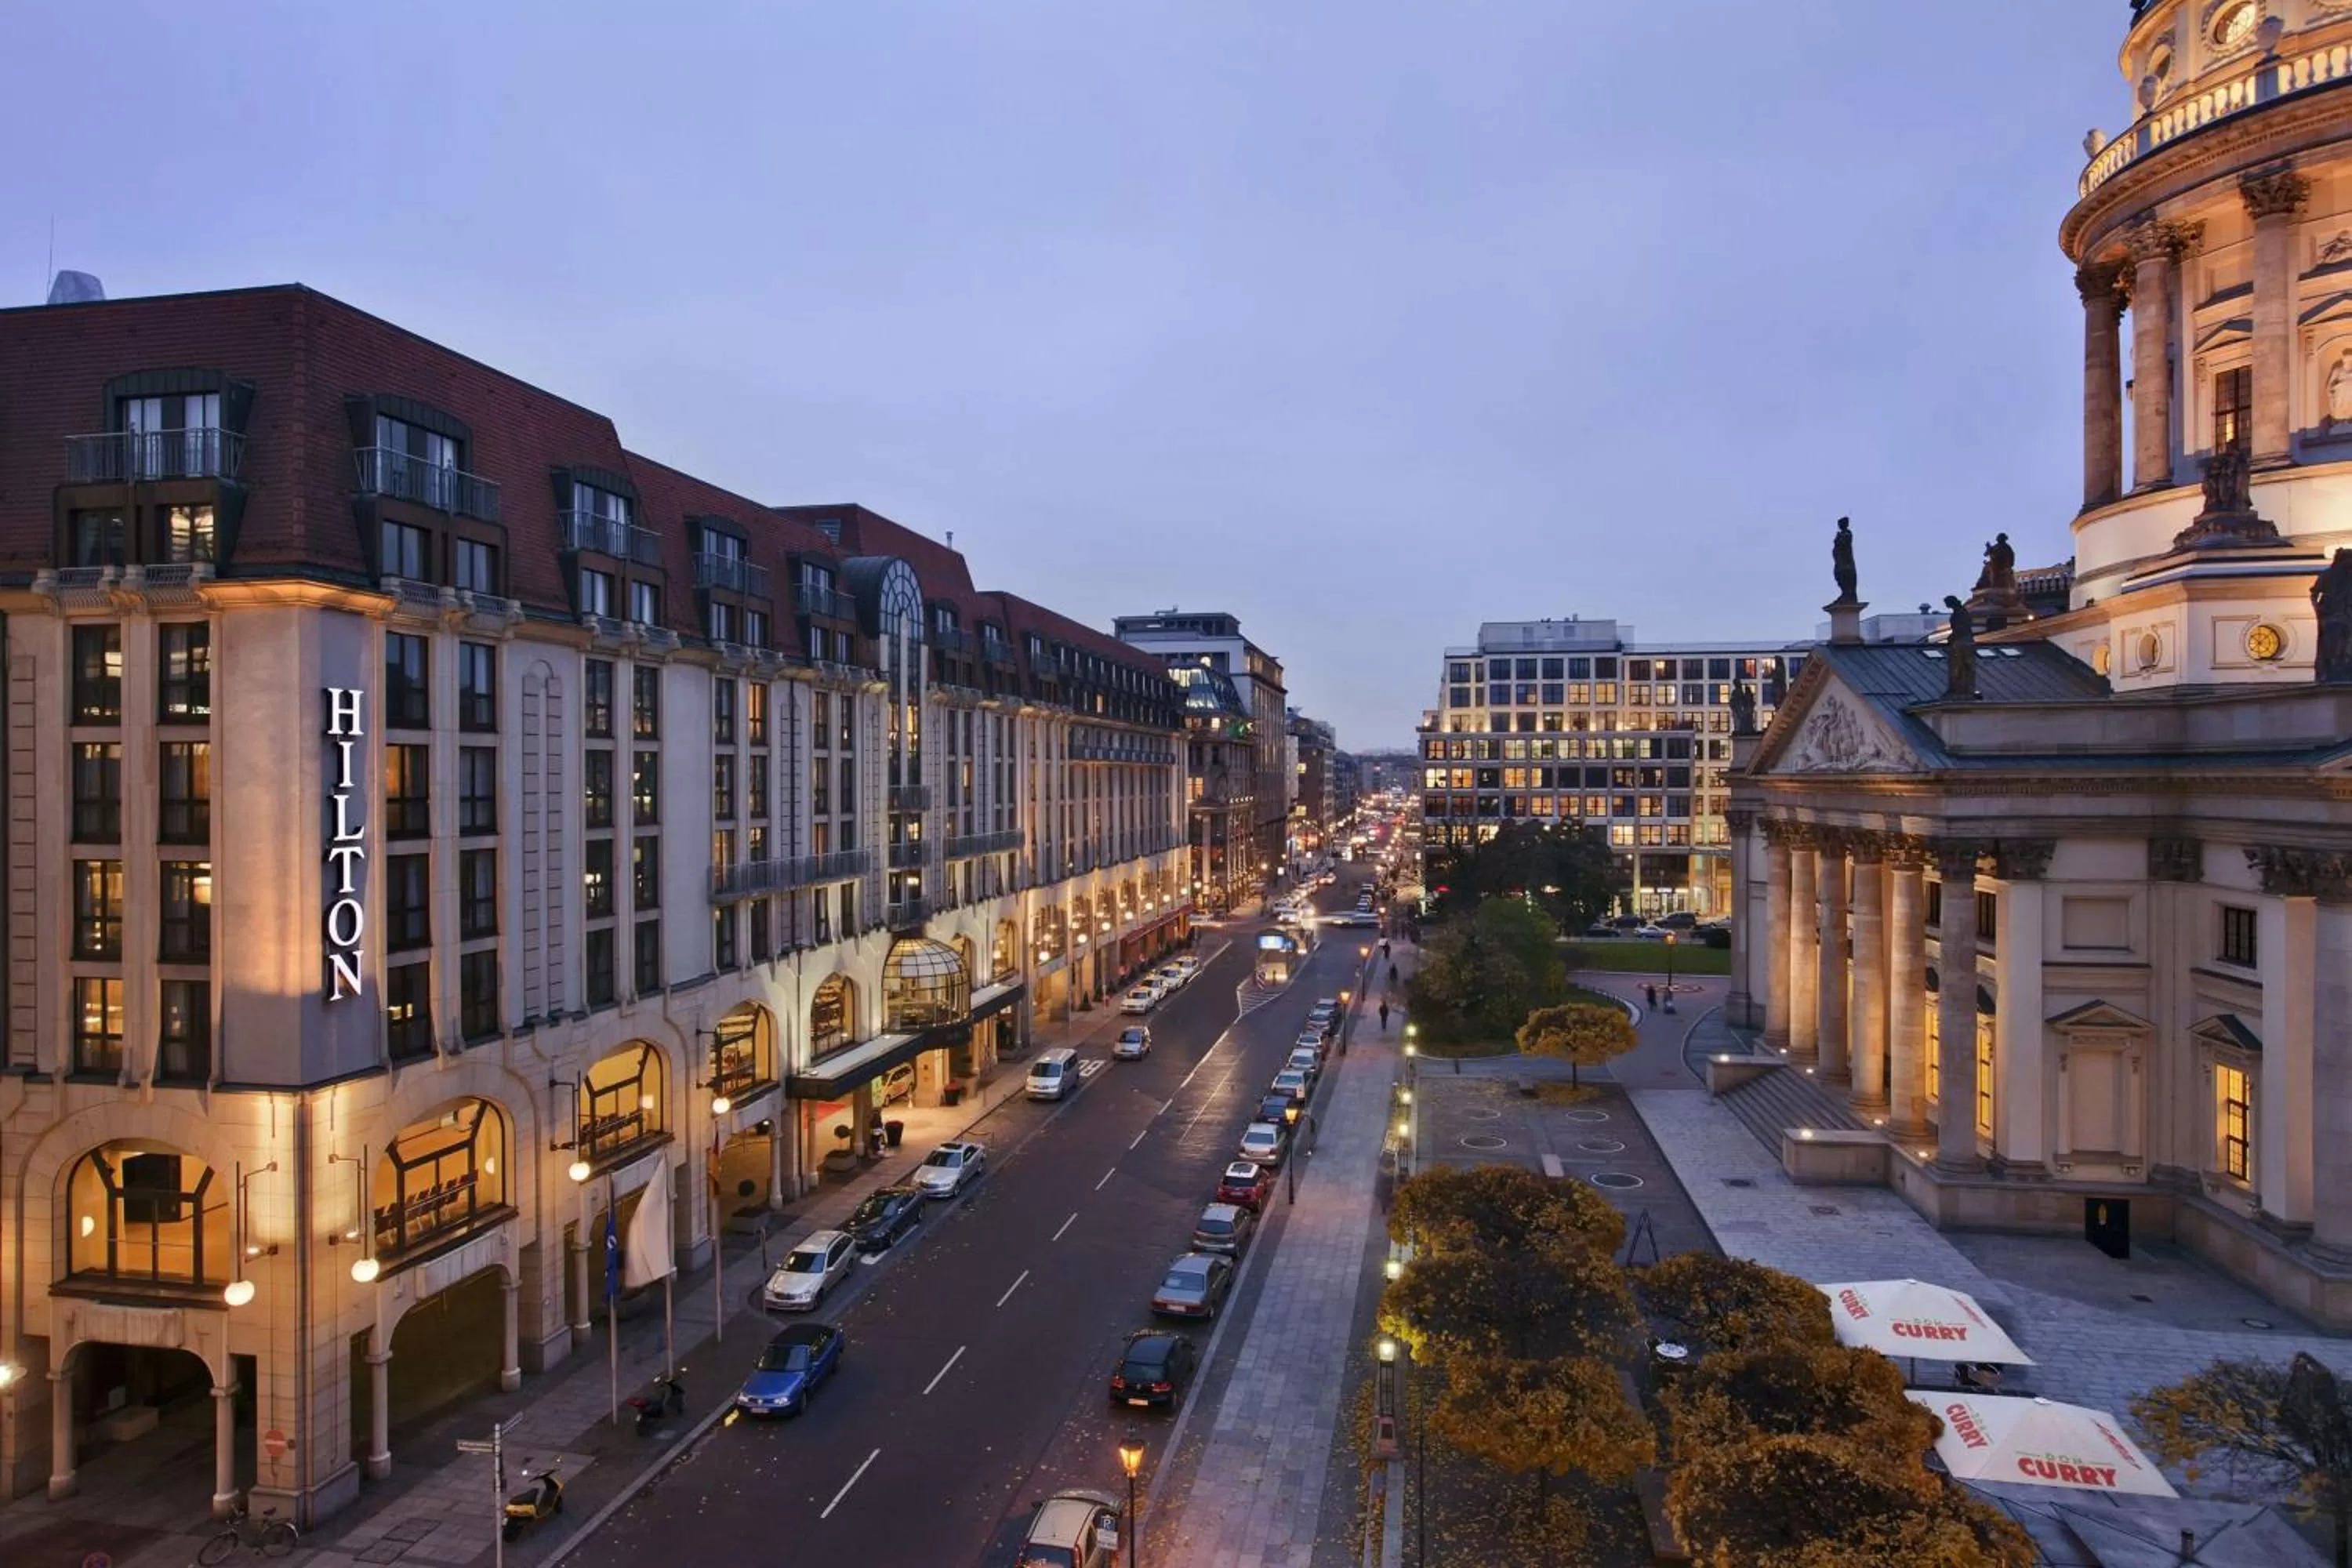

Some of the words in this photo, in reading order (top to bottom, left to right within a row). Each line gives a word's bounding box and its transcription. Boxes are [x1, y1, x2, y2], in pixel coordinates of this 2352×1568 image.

[326, 687, 365, 1001] HILTON
[1838, 1289, 1870, 1320] CURRY
[1892, 1322, 1967, 1341] CURRY
[1946, 1403, 1988, 1449] CURRY
[2018, 1457, 2116, 1487] CURRY
